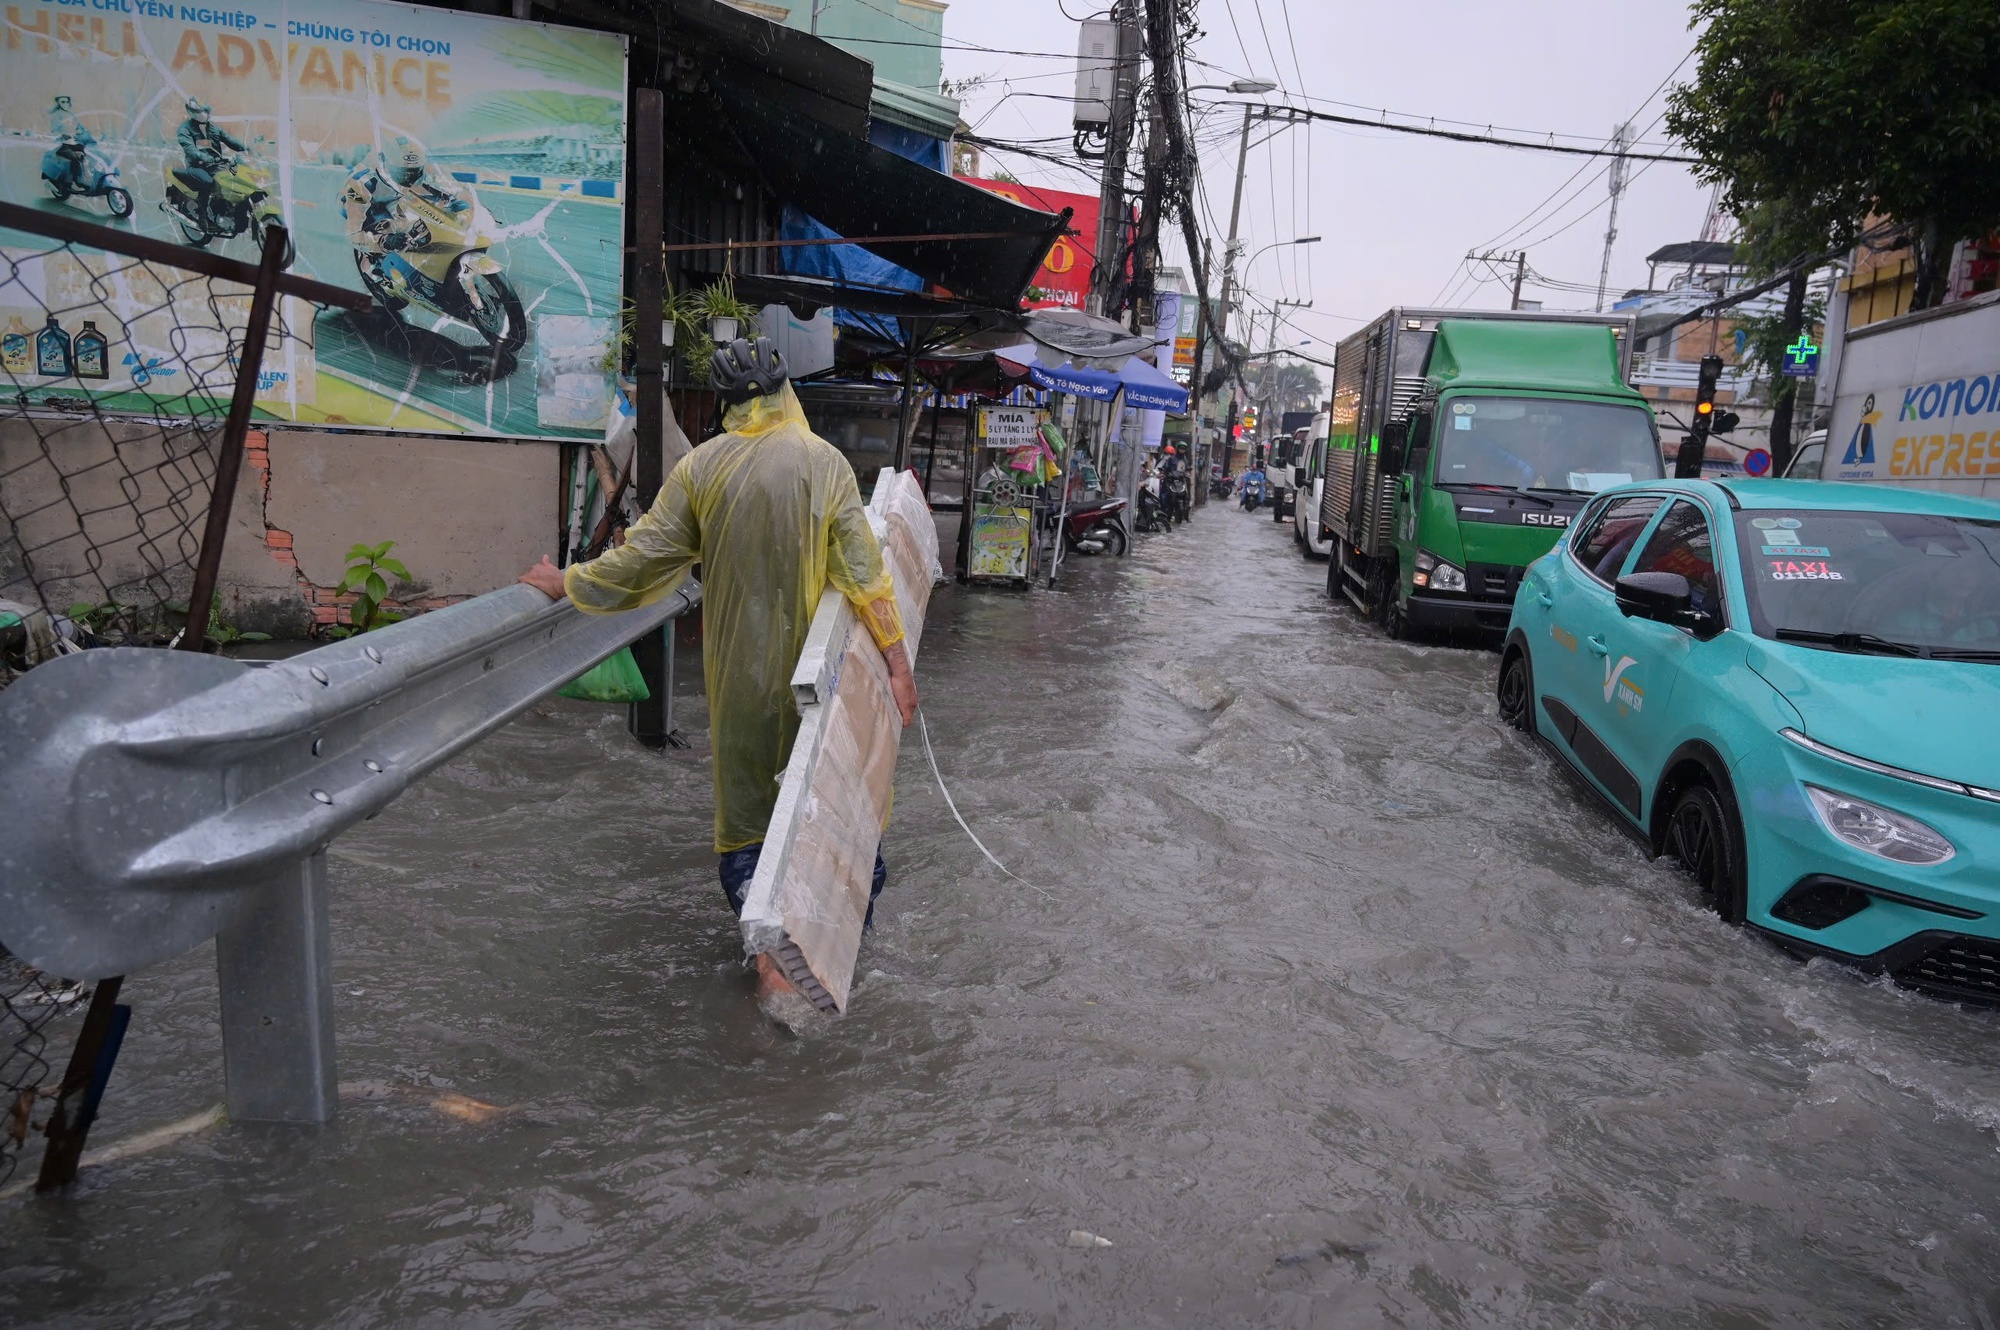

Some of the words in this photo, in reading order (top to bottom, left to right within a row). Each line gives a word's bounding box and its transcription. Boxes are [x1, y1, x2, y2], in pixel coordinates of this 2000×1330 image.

[181, 6, 257, 31] NGHIỆP
[288, 20, 354, 42] CHÚNG
[360, 29, 390, 47] TÔI
[396, 35, 450, 56] CHỌN
[172, 28, 453, 110] ADVANCE
[1056, 378, 1067, 388] Tô
[1068, 381, 1091, 393] Ngọc
[1092, 385, 1109, 395] Vân
[998, 412, 1025, 423] MÍA
[988, 425, 993, 433] 5
[1771, 561, 1830, 574] TAXI
[1772, 571, 1844, 581] 01154B
